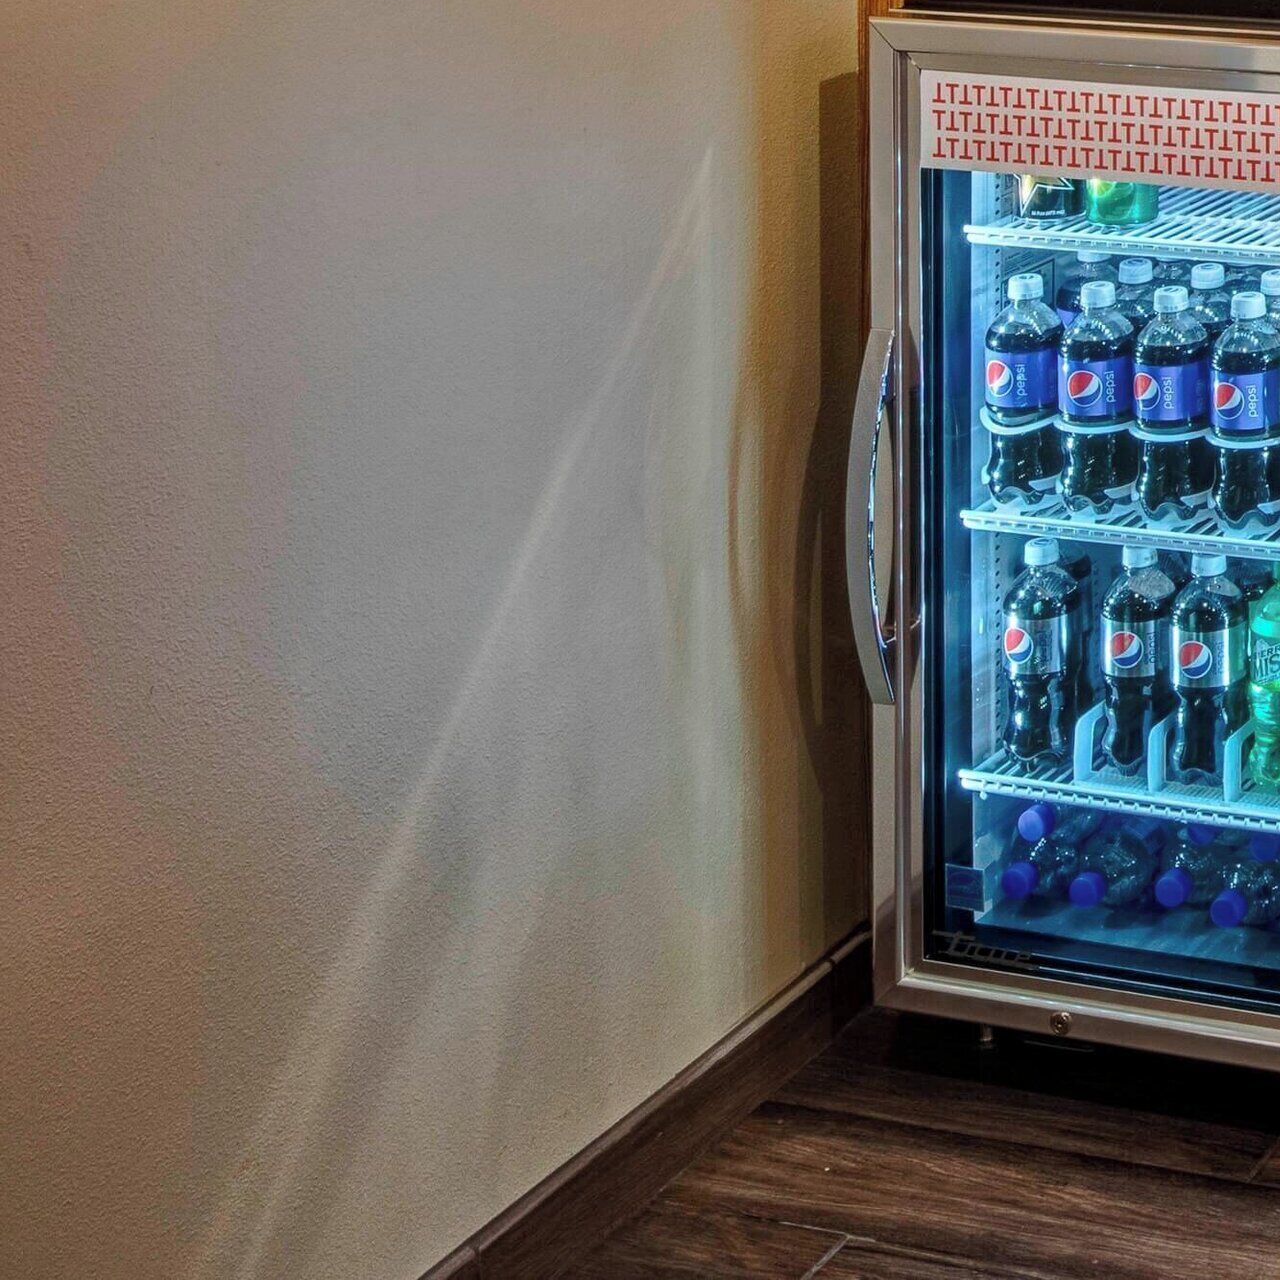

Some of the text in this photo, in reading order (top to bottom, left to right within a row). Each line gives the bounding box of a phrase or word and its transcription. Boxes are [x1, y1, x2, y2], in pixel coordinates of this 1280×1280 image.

[1016, 363, 1027, 397] pepsi
[1107, 370, 1115, 403] pepsi
[1163, 376, 1173, 410] pepsi
[1247, 384, 1258, 419] pepsi
